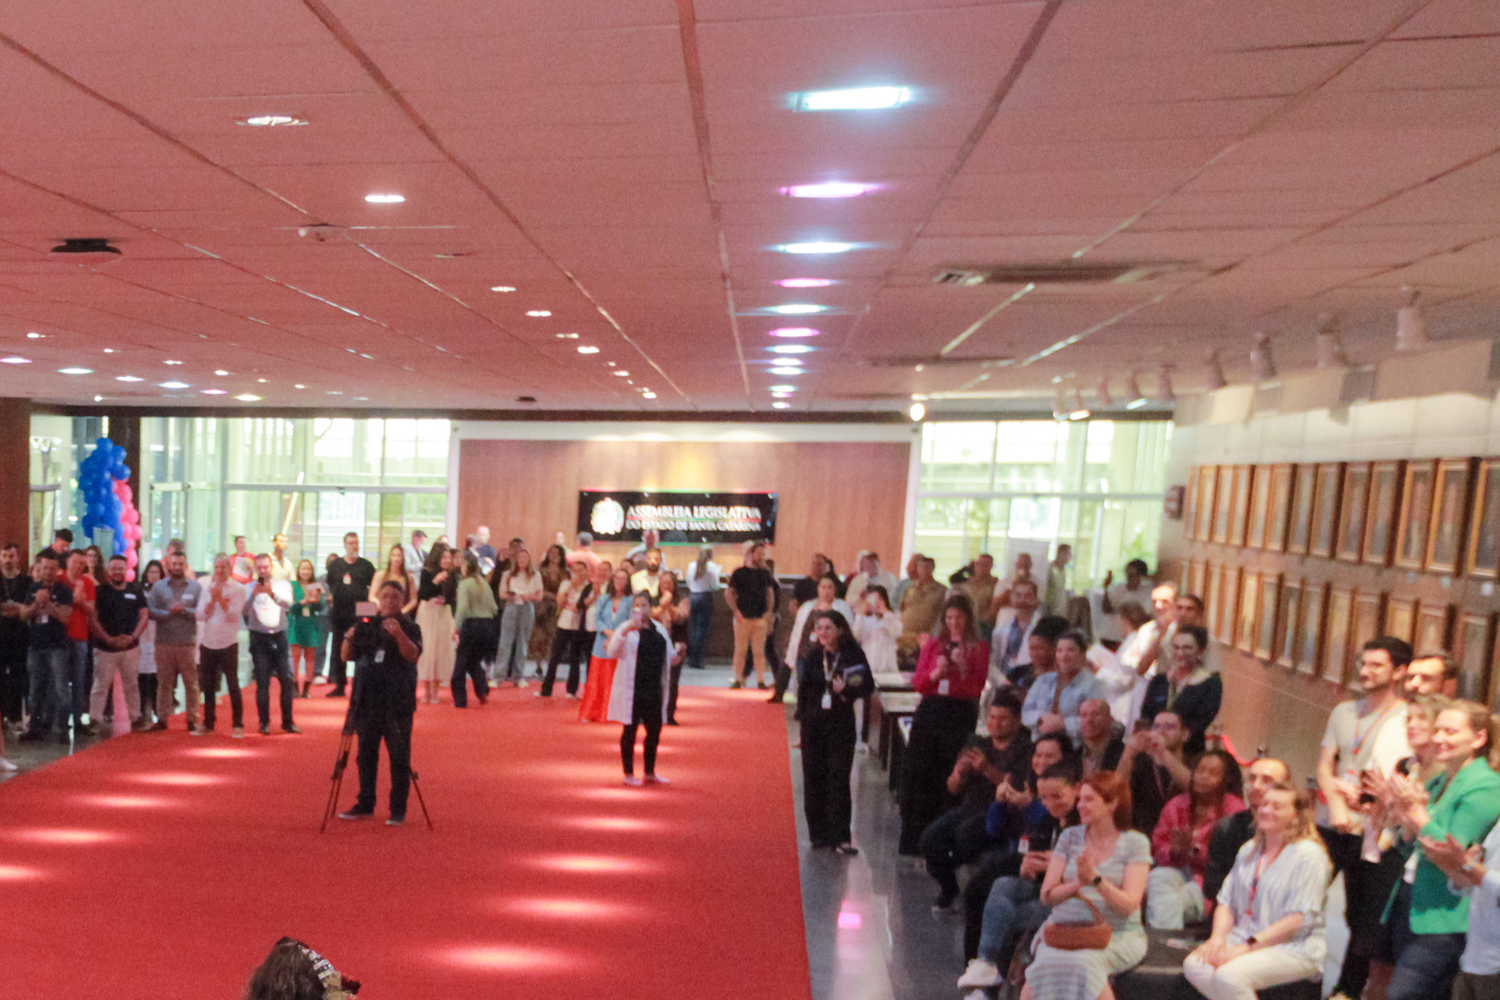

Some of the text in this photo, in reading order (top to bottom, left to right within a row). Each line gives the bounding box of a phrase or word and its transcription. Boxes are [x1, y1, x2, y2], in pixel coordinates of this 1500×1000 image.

[627, 505, 761, 519] ASSEMBLEIA LEGISLATIVA
[626, 519, 761, 531] DO ESTADO DE SANTA CATARINA
